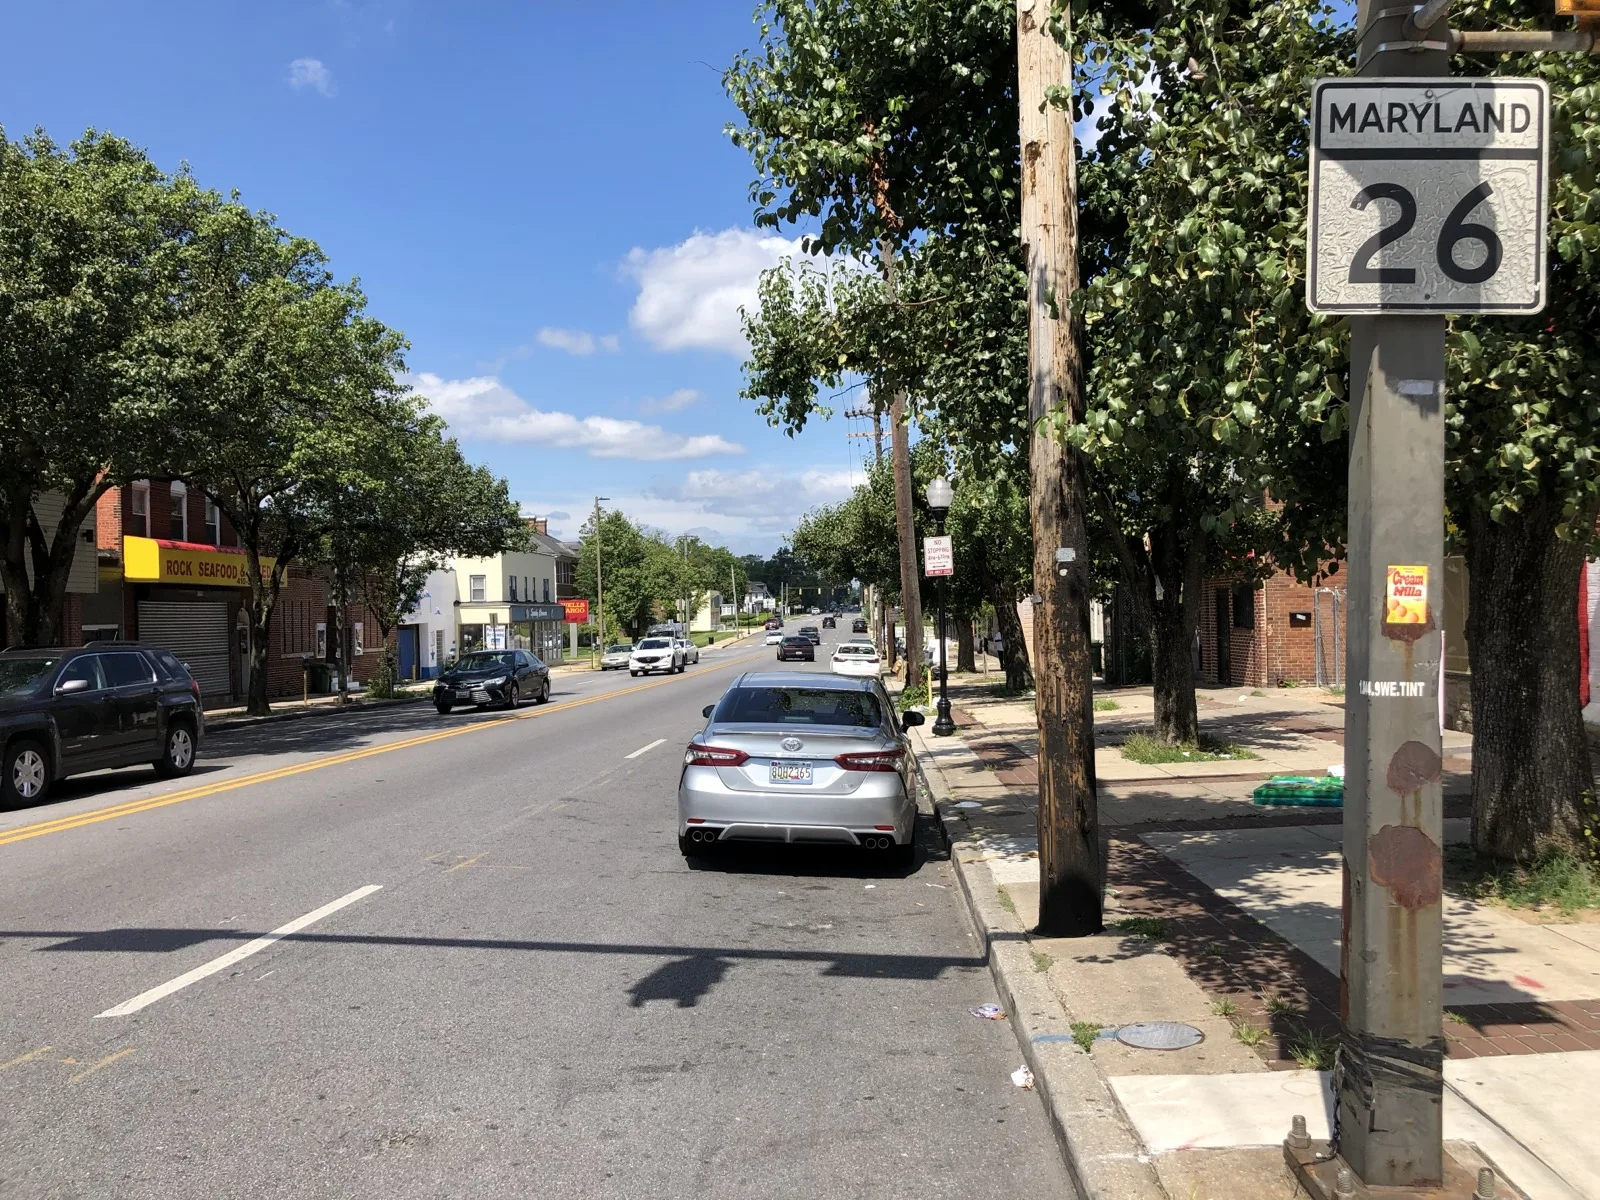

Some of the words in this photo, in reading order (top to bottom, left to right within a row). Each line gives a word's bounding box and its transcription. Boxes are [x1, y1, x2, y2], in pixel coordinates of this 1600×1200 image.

[1329, 102, 1531, 133] MARYLAND
[1347, 180, 1503, 284] 26
[166, 560, 193, 576] ROCK
[198, 561, 238, 579] SEAFOOD
[240, 563, 246, 577] &
[1393, 571, 1423, 585] Cream
